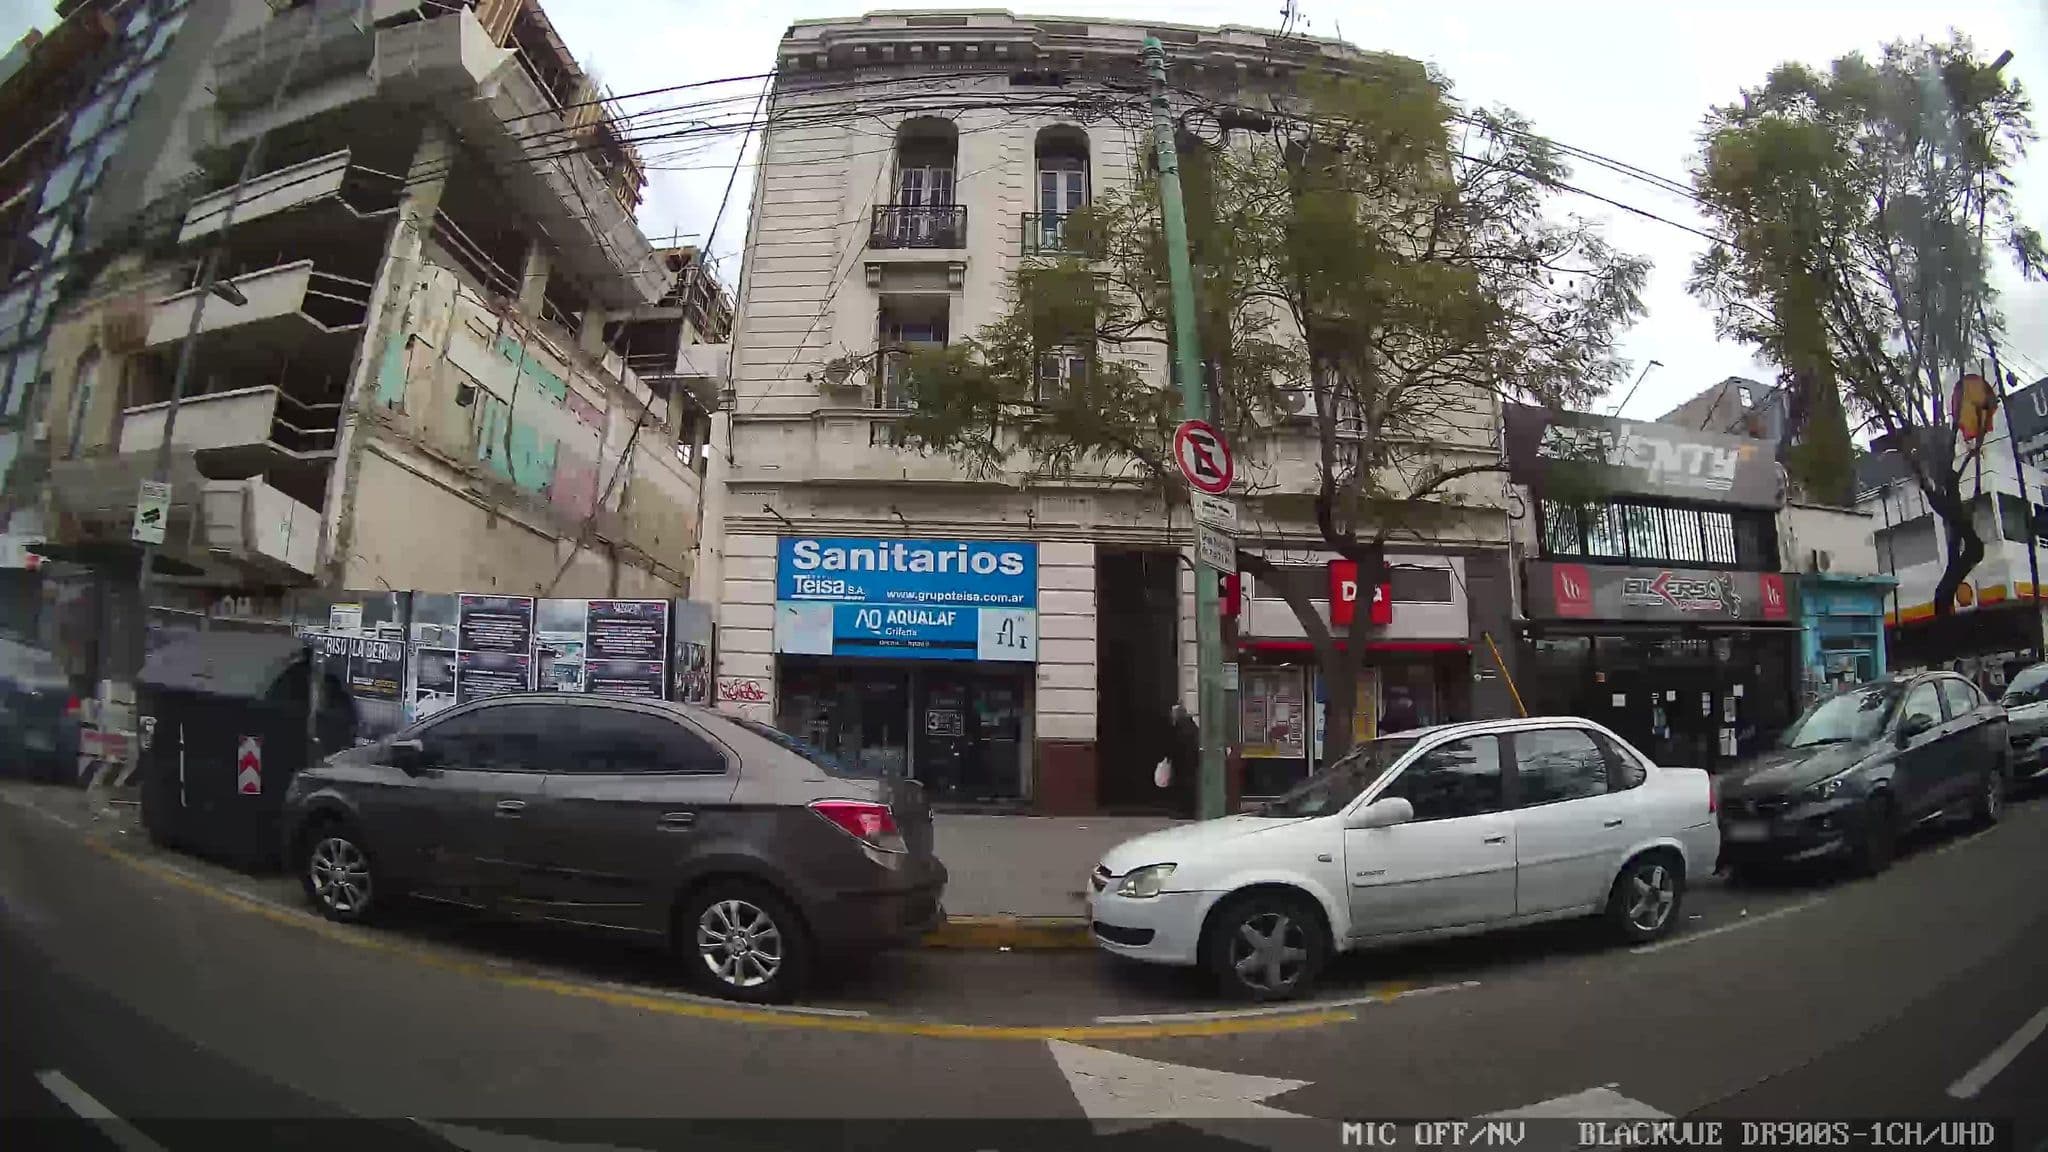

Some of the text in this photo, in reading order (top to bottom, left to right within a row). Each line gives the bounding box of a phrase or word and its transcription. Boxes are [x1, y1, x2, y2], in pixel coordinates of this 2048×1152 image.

[792, 540, 1024, 575] Sanitarios
[793, 575, 845, 594] Teisa
[1341, 581, 1382, 602] Da
[886, 590, 1024, 603] www.grupoteisa.com.ar
[887, 610, 957, 626] AQUALAF
